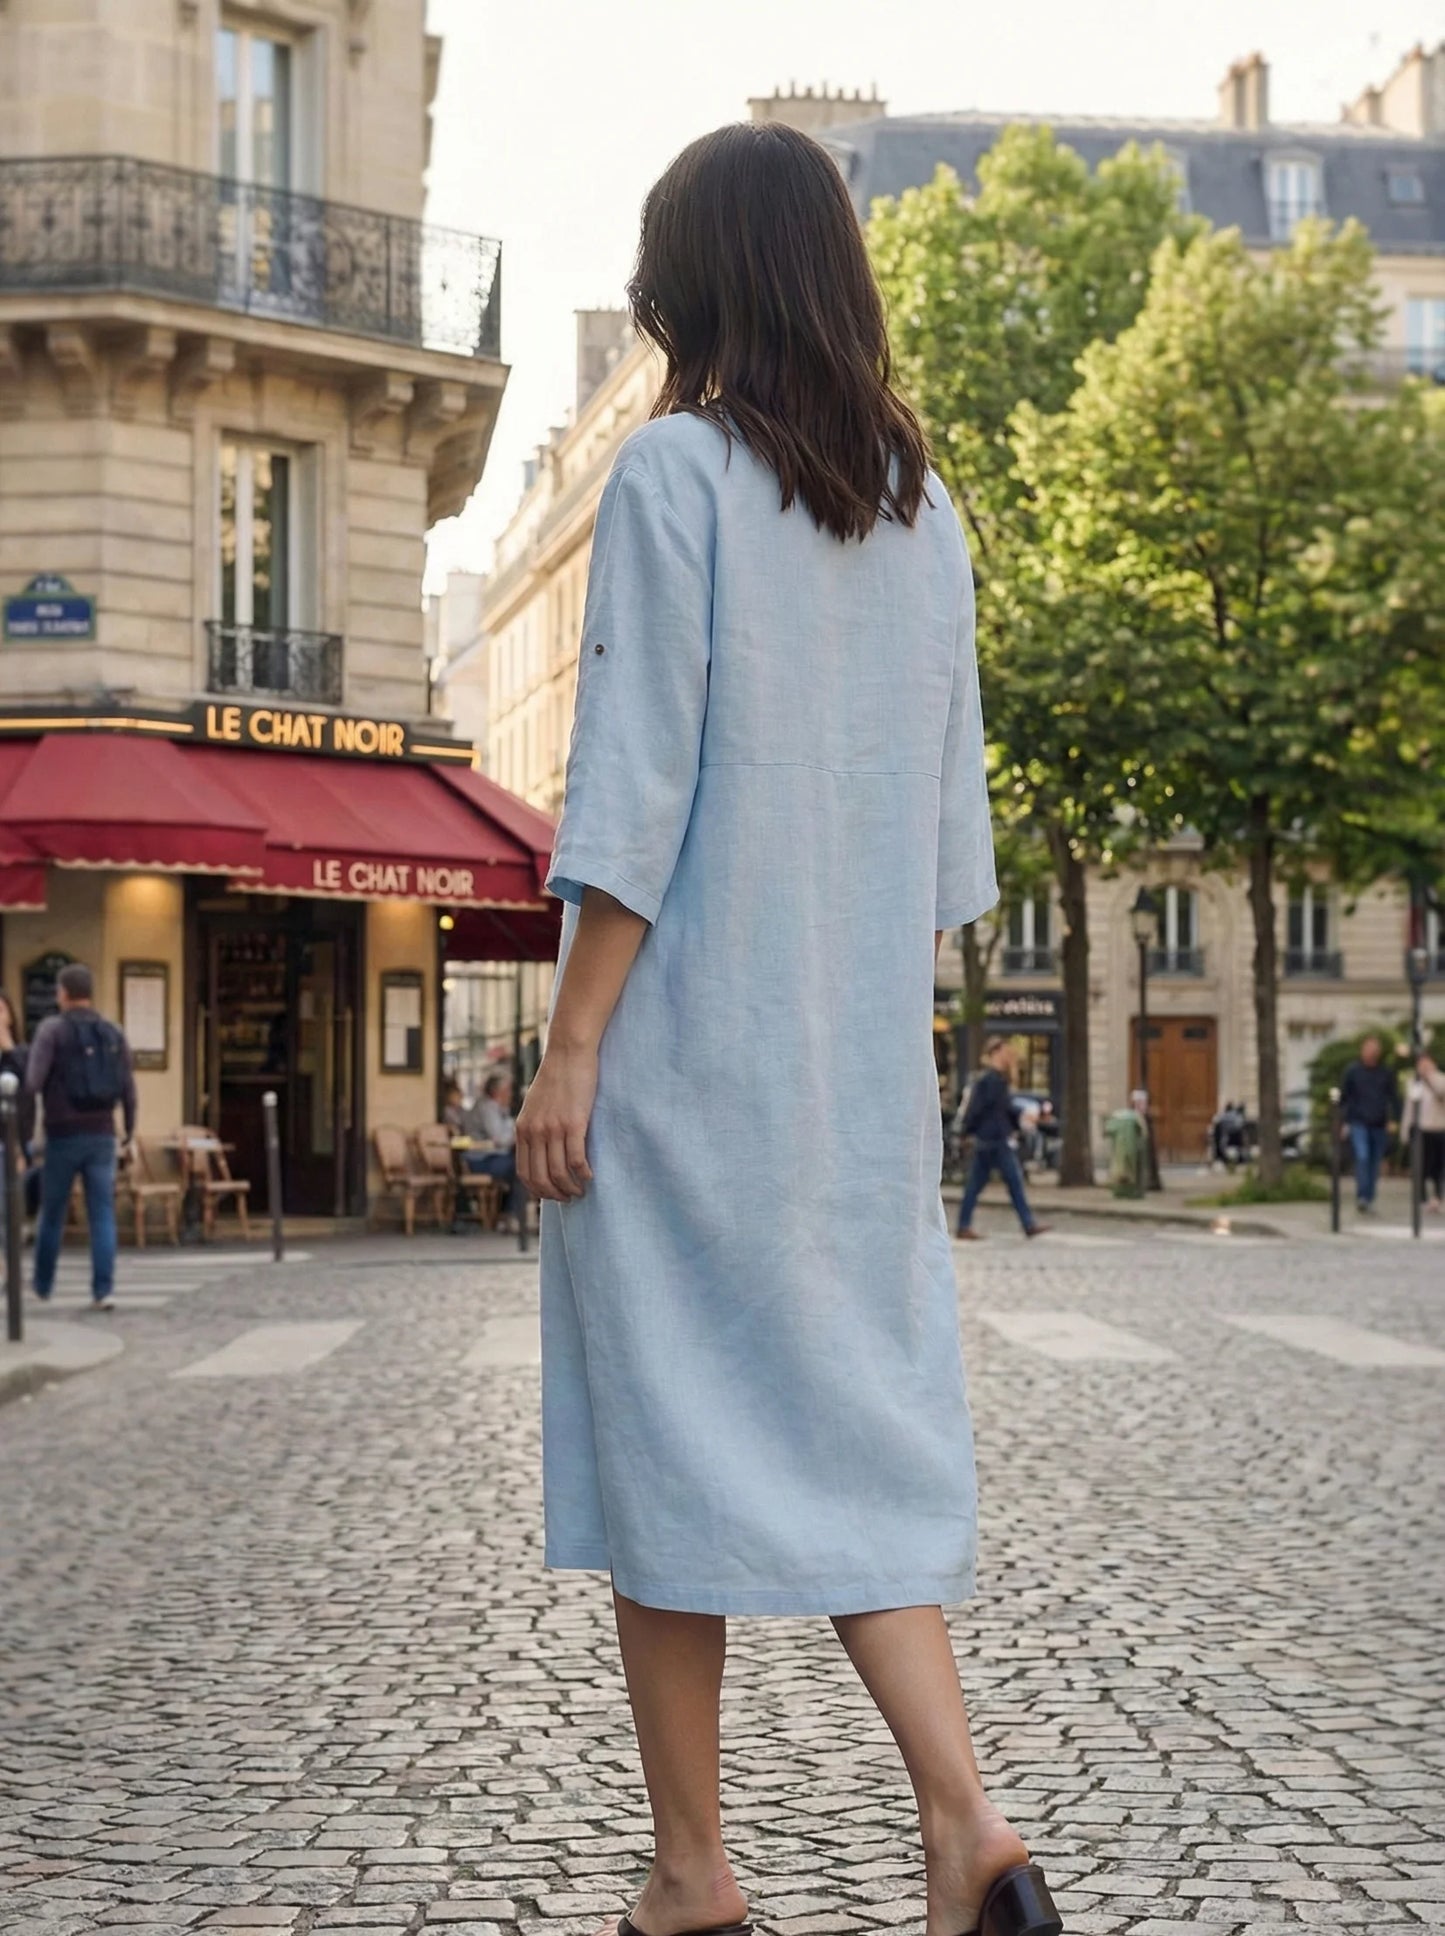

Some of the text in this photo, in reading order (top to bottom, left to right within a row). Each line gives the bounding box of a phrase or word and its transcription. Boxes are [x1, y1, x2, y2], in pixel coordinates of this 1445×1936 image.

[206, 705, 405, 756] LE CHAT NOIR
[313, 859, 474, 895] LE CHAT NOIR
